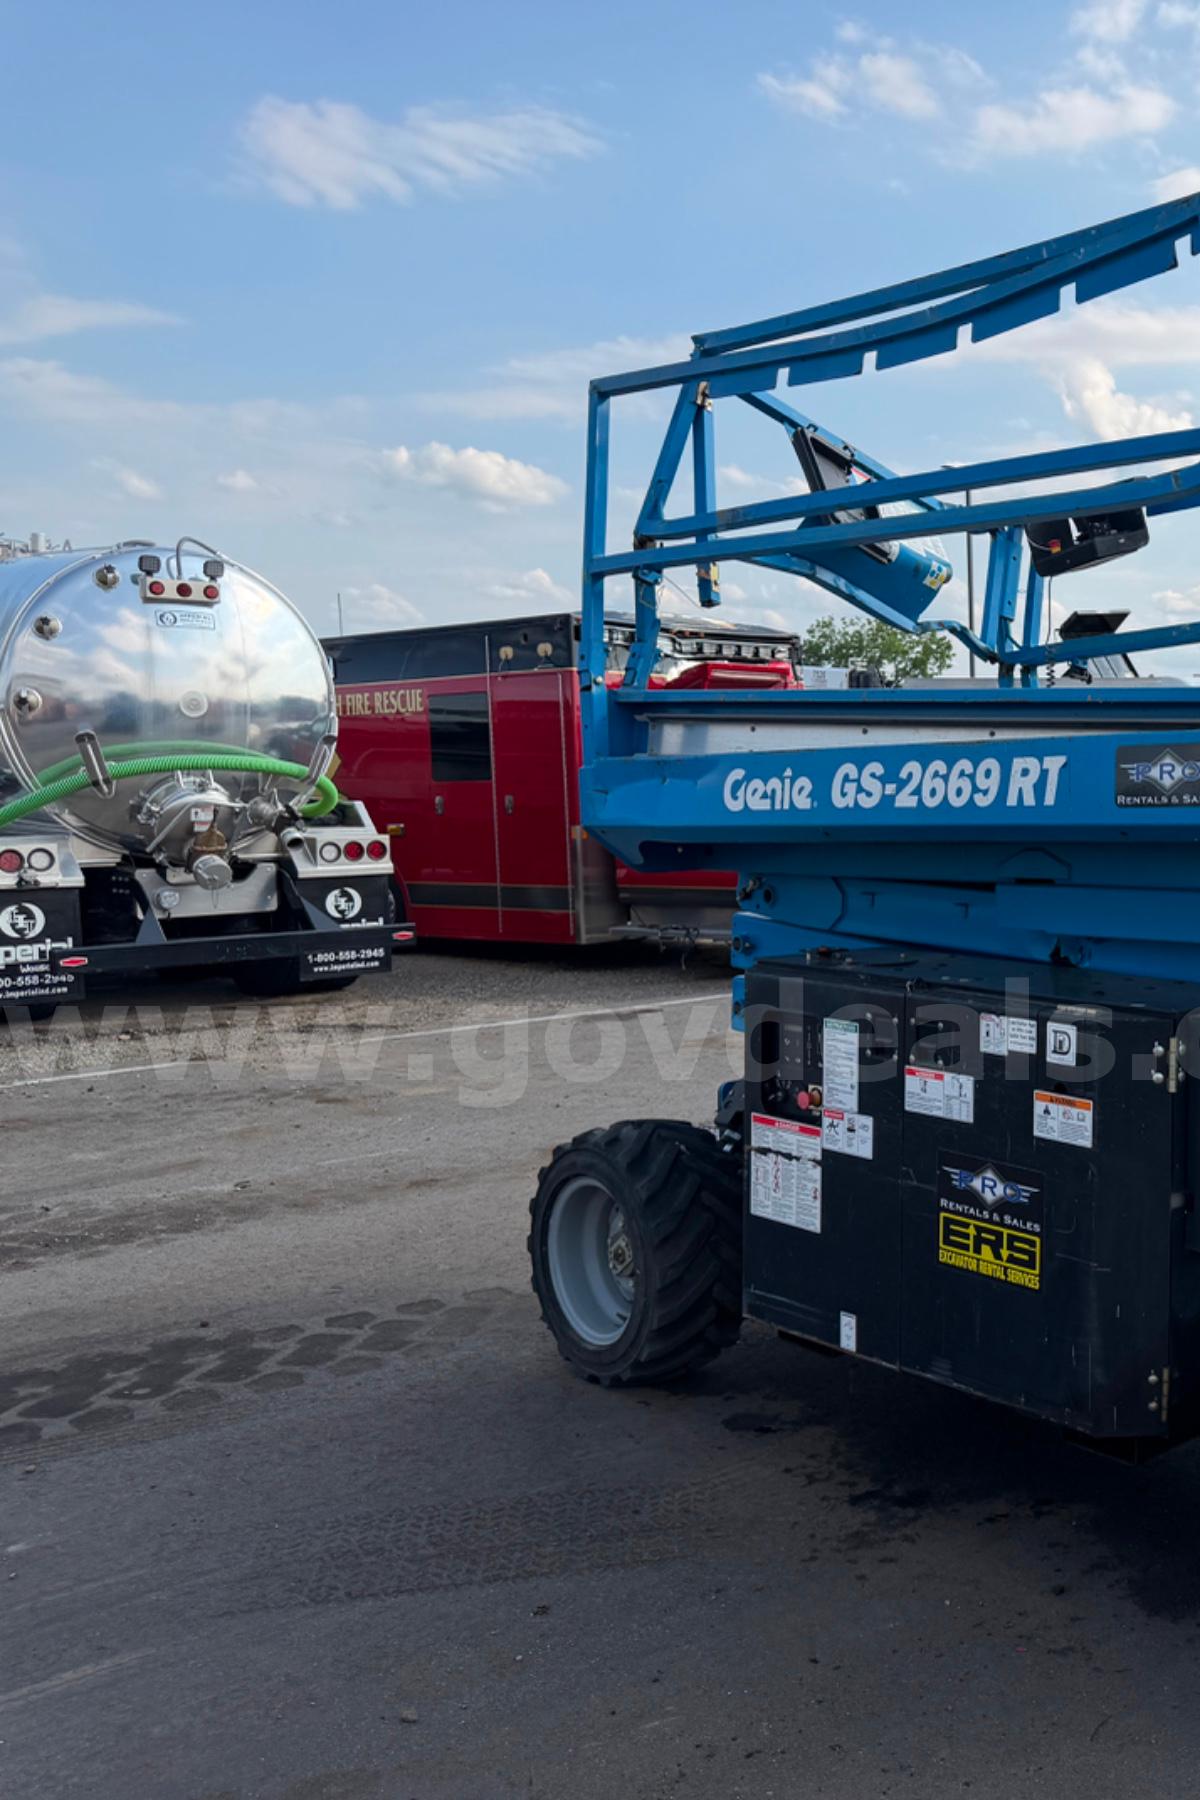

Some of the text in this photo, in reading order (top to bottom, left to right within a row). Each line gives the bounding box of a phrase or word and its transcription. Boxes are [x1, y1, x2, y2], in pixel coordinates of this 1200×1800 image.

[346, 692, 372, 716] FIRE
[374, 688, 424, 714] RESCUE
[723, 755, 1067, 812] Genie GS-2669 RT
[940, 1198, 989, 1220] RENTALS
[1003, 1213, 1041, 1233] SALES
[942, 1215, 1038, 1272] ERS
[939, 1249, 1040, 1290] EXCAVATOR RENTAL SERVICES
